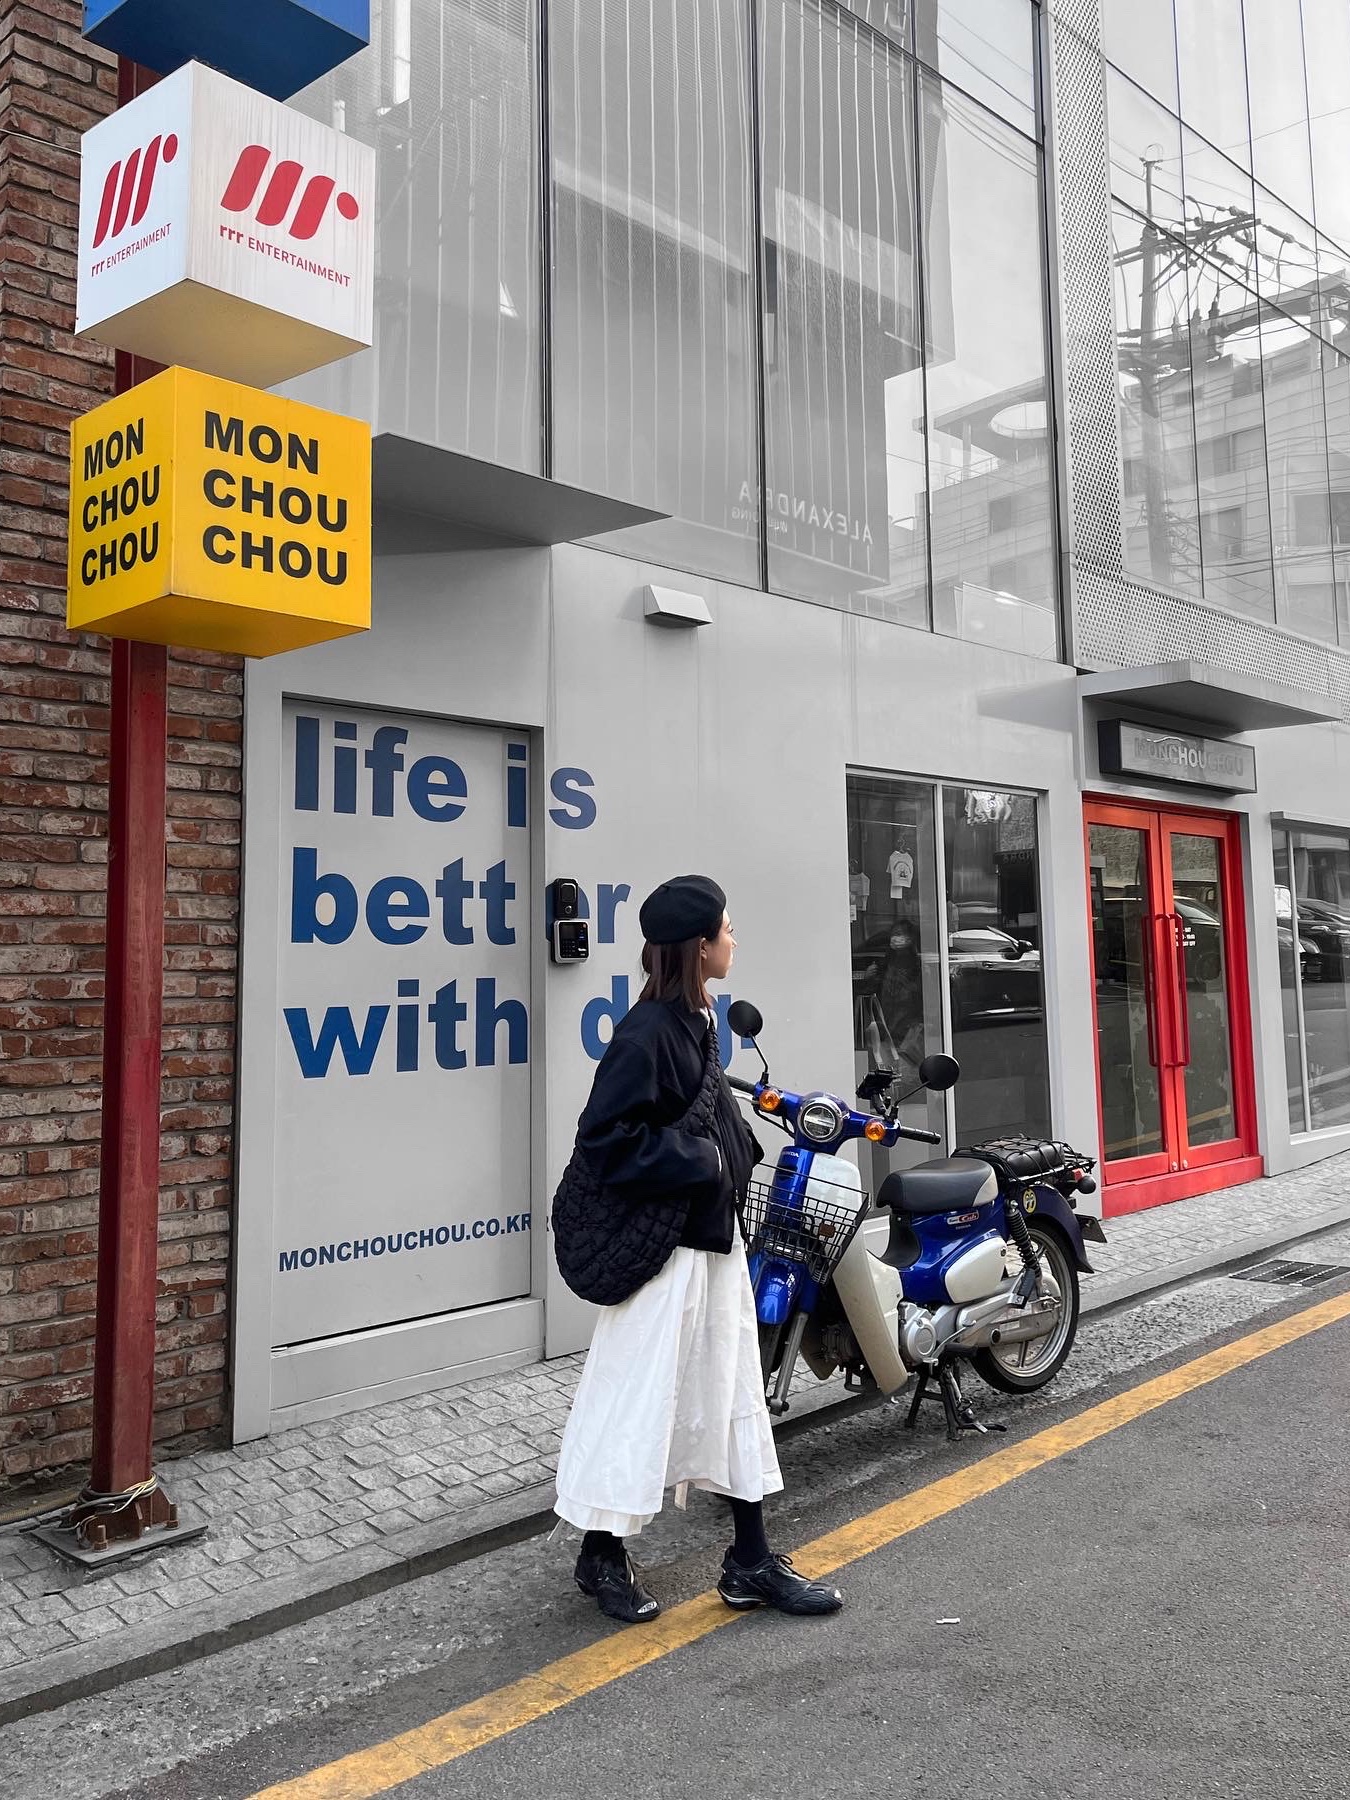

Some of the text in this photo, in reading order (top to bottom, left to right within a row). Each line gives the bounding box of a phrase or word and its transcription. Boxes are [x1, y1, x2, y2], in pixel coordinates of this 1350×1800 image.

[107, 222, 171, 268] ENTERTAINMENT
[220, 225, 350, 287] rrr ENTERTAINMENT
[84, 418, 144, 481] MON
[204, 410, 319, 475] MON
[83, 465, 160, 532] CHOU
[203, 469, 347, 533] CHOU
[82, 521, 159, 586] CHOU
[202, 525, 347, 585] CHOU
[294, 715, 597, 830] life is
[283, 976, 529, 1080] with
[279, 1212, 531, 1272] MONCHOUCHOU.CO.KR
